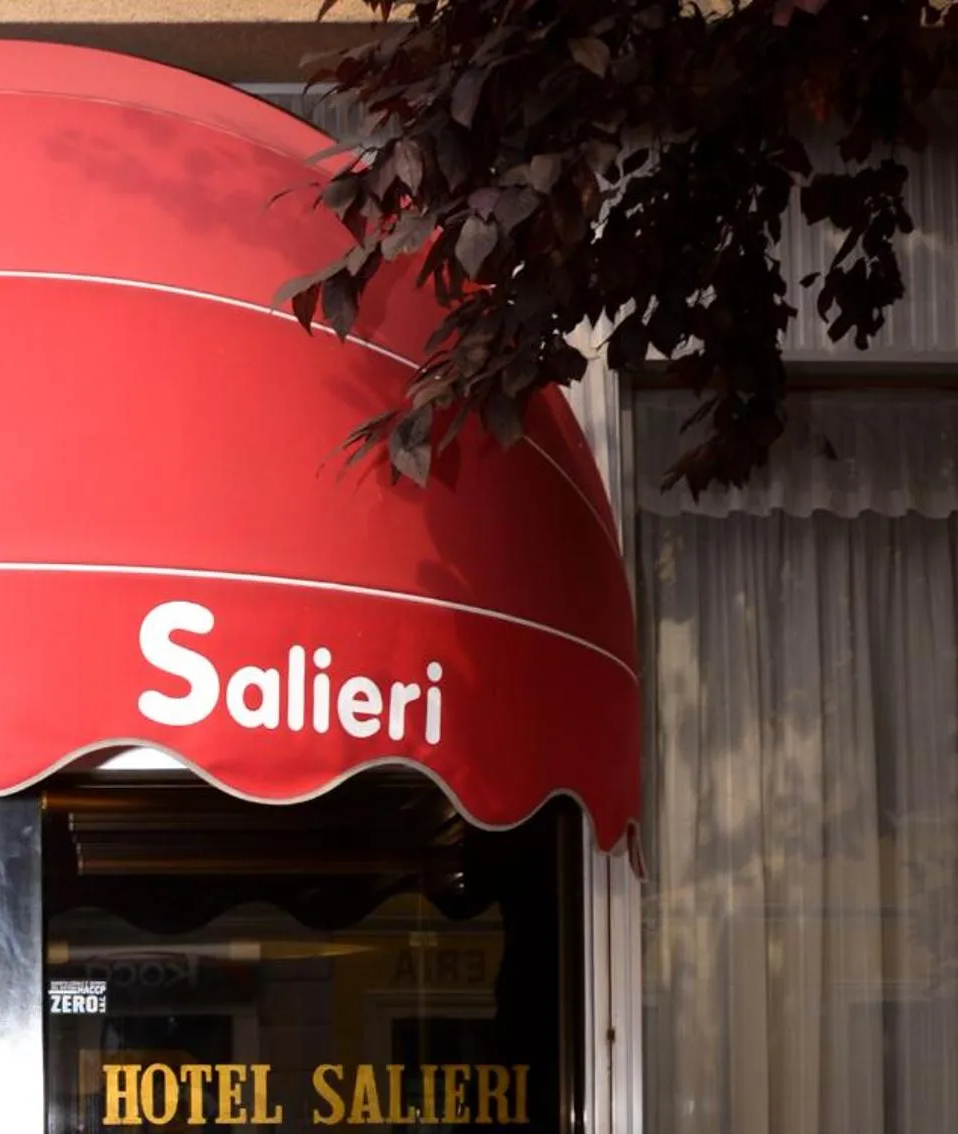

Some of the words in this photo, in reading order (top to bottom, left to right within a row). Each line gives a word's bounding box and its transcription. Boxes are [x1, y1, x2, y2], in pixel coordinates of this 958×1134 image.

[137, 600, 442, 745] Salieri
[50, 994, 98, 1013] ZERO
[102, 1062, 283, 1126] HOTEL
[312, 1062, 531, 1126] SALIERI
